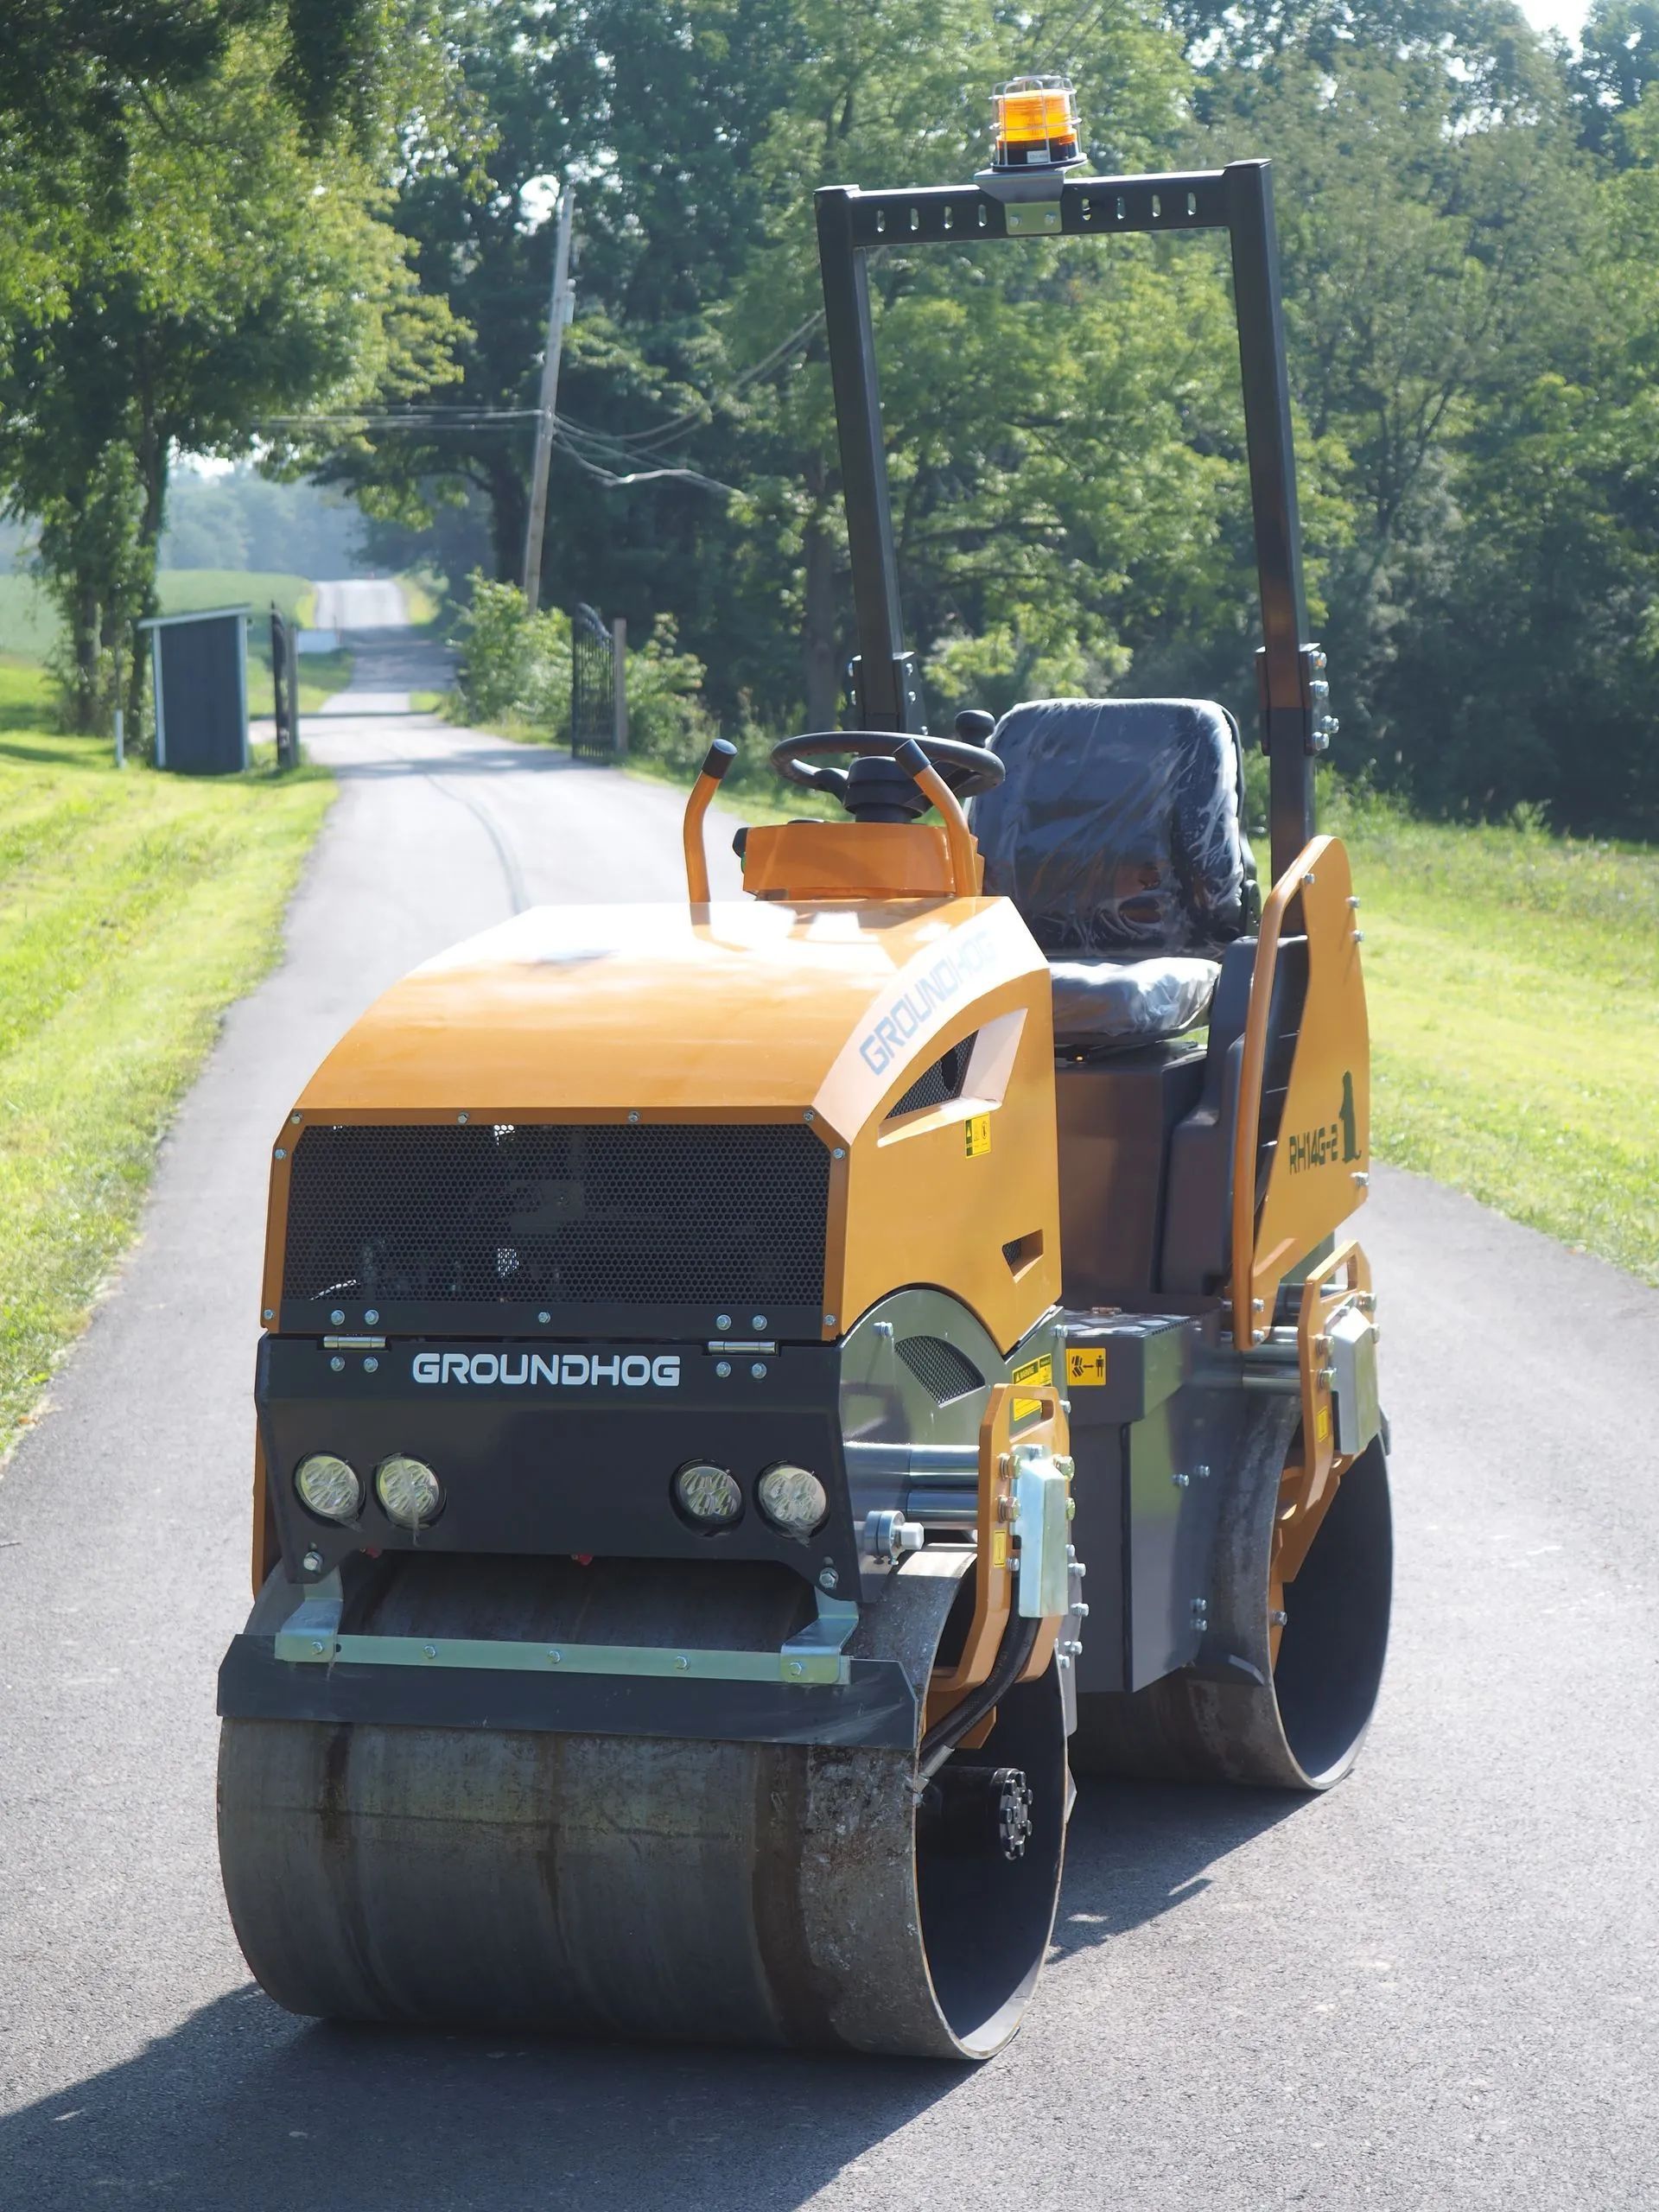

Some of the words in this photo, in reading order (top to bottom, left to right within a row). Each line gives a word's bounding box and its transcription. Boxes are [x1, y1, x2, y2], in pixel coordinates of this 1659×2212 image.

[859, 930, 996, 1076] GROUNDHOG
[1289, 1123, 1338, 1175] RH14G-2
[412, 1353, 681, 1386] GROUNDHOG
